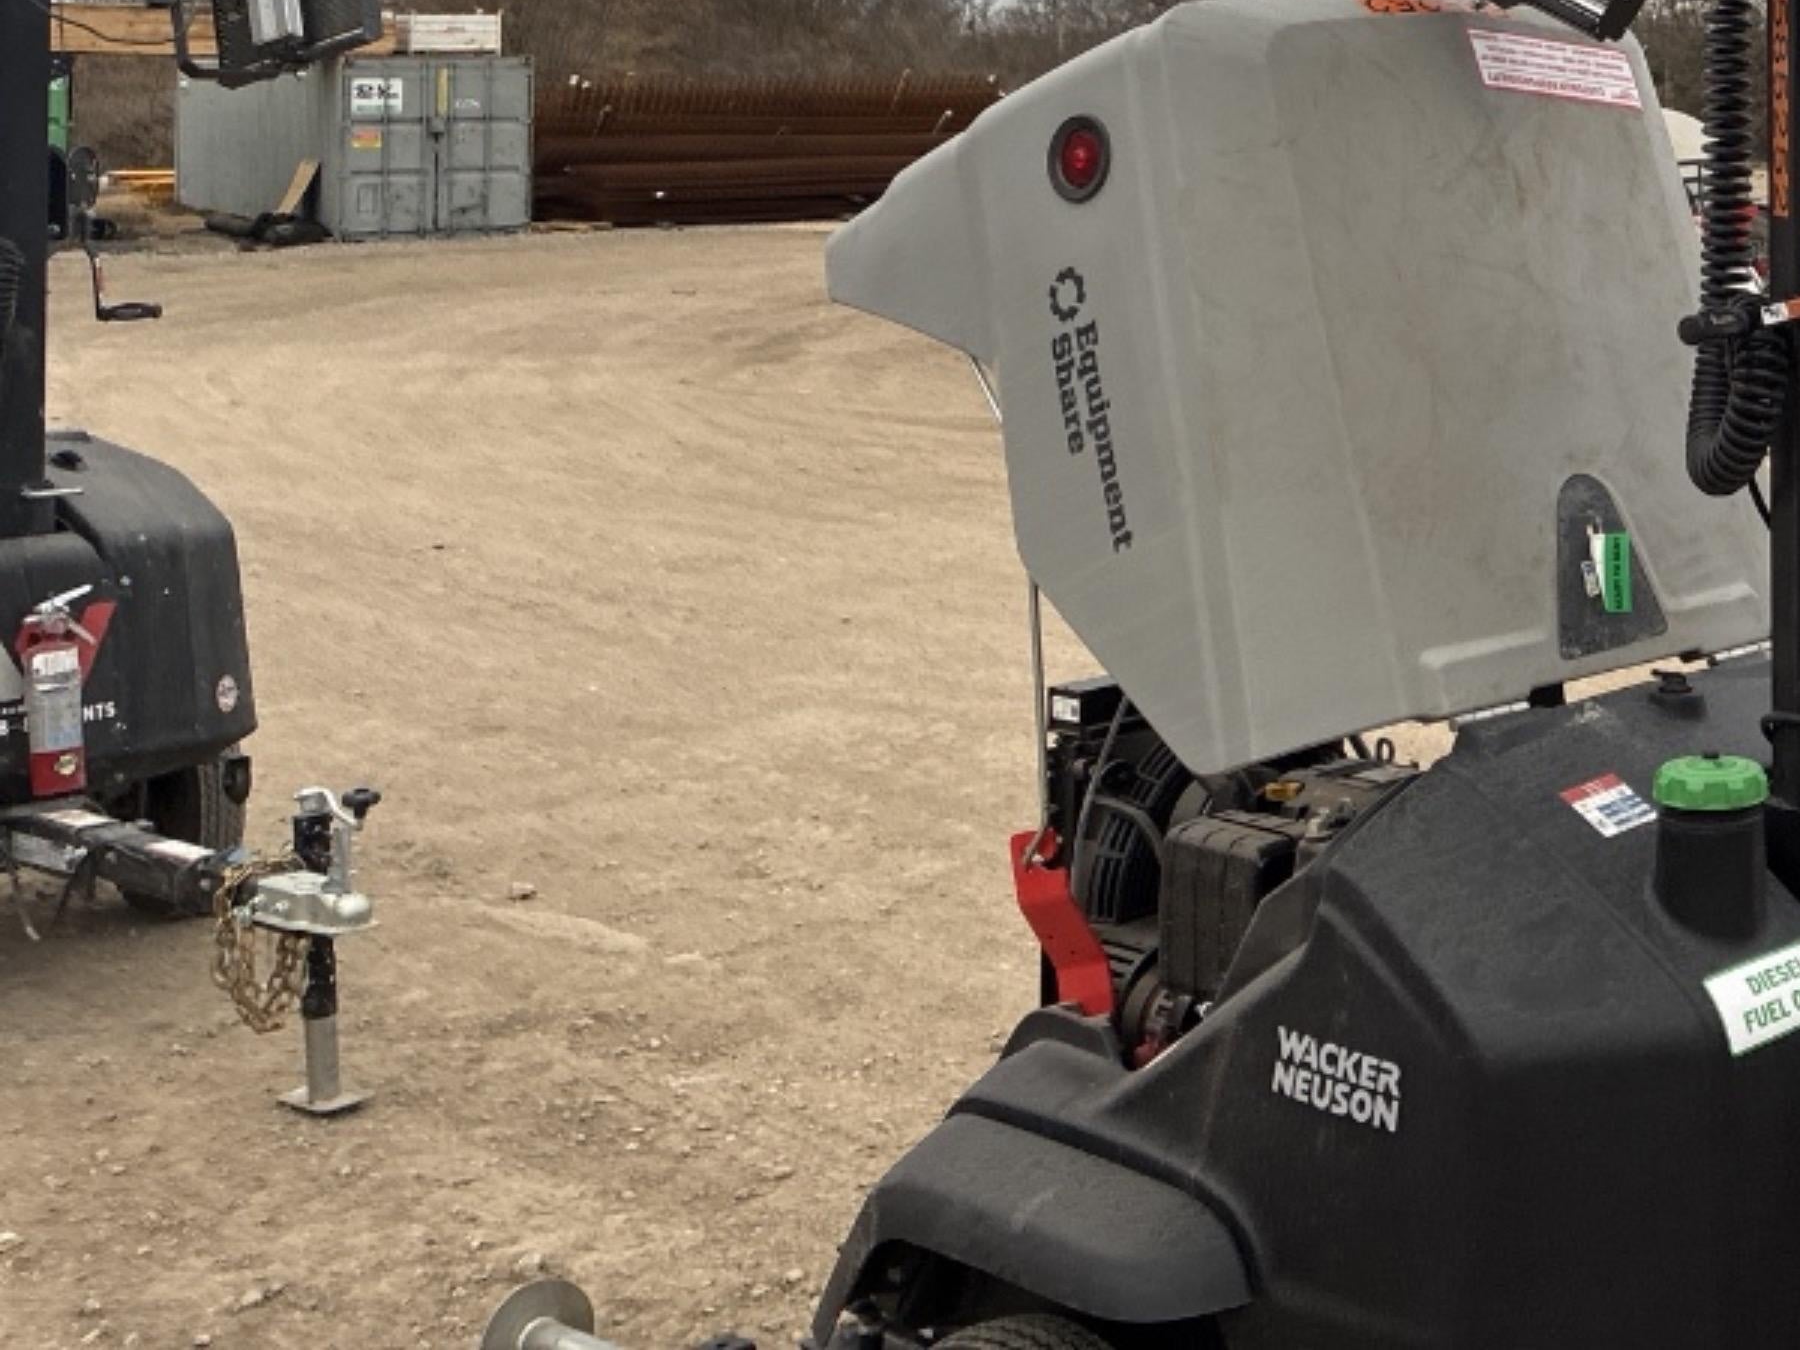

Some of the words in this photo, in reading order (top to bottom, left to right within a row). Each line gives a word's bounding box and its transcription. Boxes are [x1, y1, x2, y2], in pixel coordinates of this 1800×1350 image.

[1051, 332, 1085, 454] Share
[1076, 319, 1133, 554] Equipment
[1743, 999, 1792, 1036] FUEL
[1271, 1060, 1399, 1132] NEUSON
[1277, 1025, 1401, 1098] WACKER
